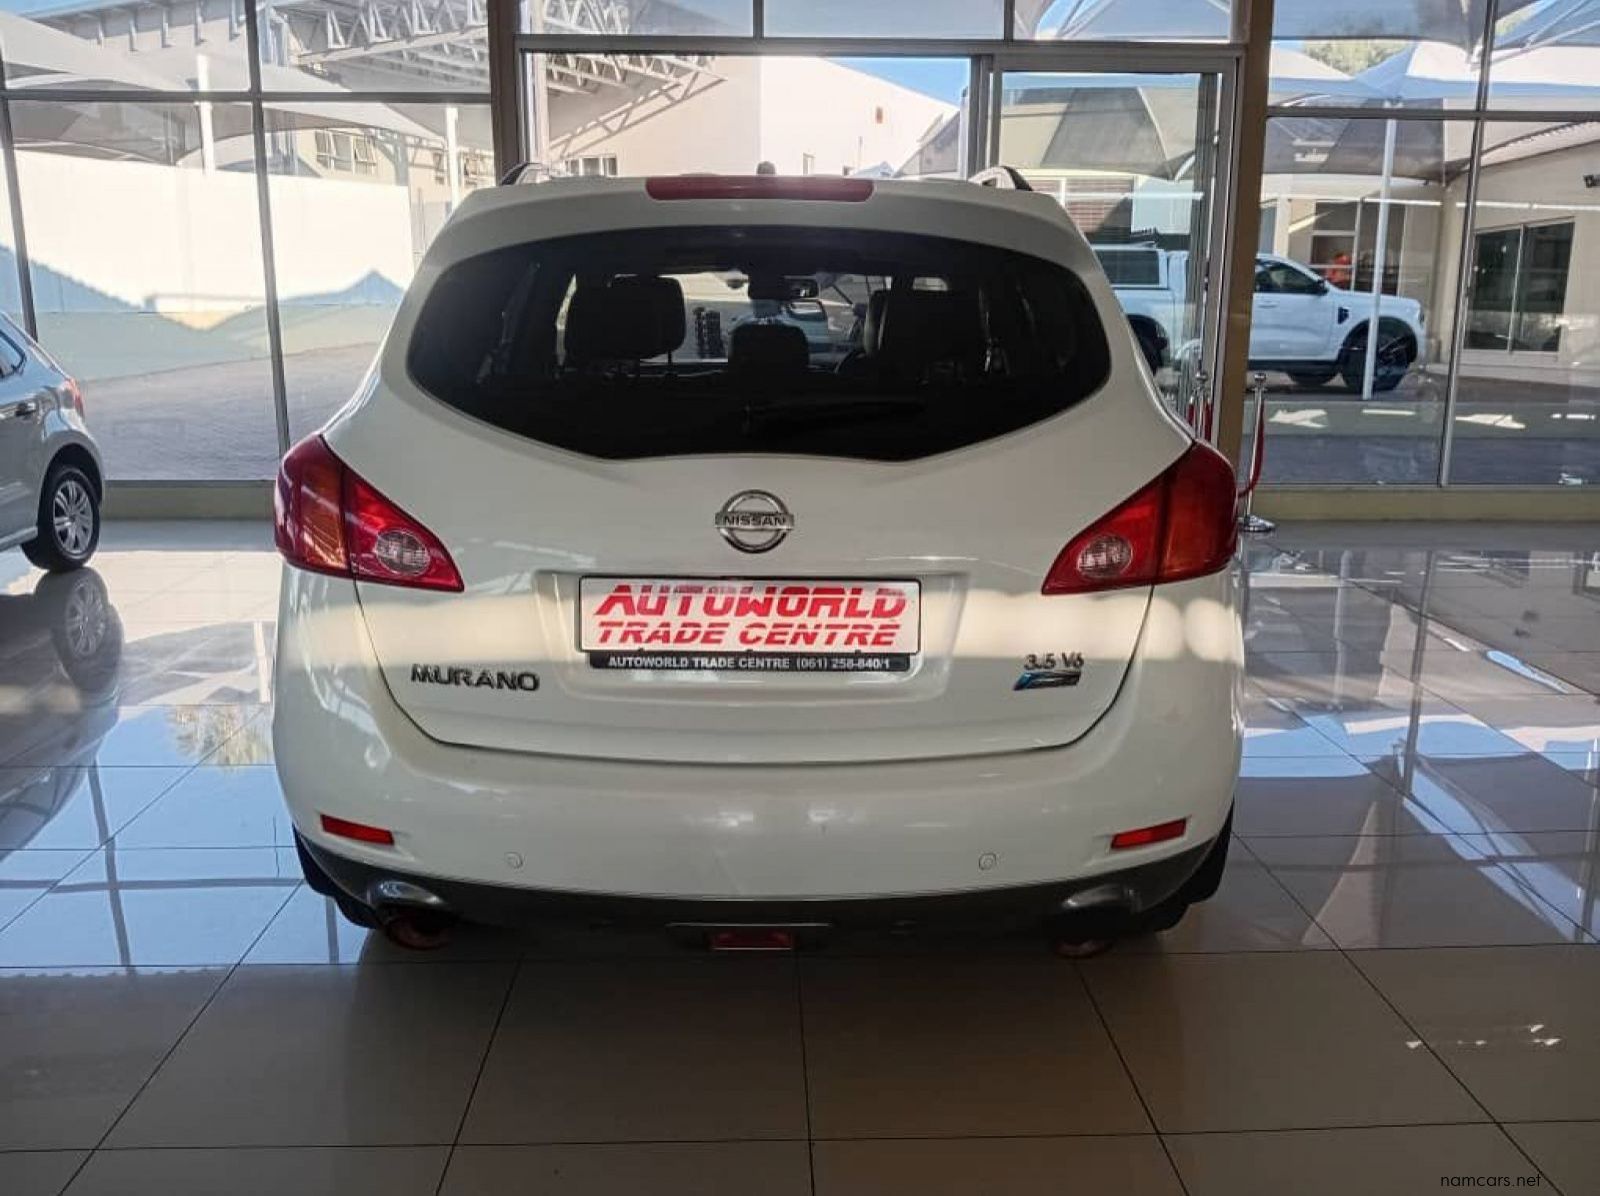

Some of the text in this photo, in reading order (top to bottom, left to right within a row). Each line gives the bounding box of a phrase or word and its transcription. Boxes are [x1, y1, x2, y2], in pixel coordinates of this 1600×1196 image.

[722, 514, 786, 526] NISSAN
[594, 584, 907, 618] AUTOWORLD
[597, 621, 900, 647] TRADE CENTRE
[608, 656, 687, 668] AUTOWORLD
[693, 656, 735, 669] TRADE
[738, 657, 790, 669] CENTRE
[797, 657, 828, 670] (061)
[1024, 652, 1085, 670] 3.5 V6
[411, 664, 540, 691] MURANO
